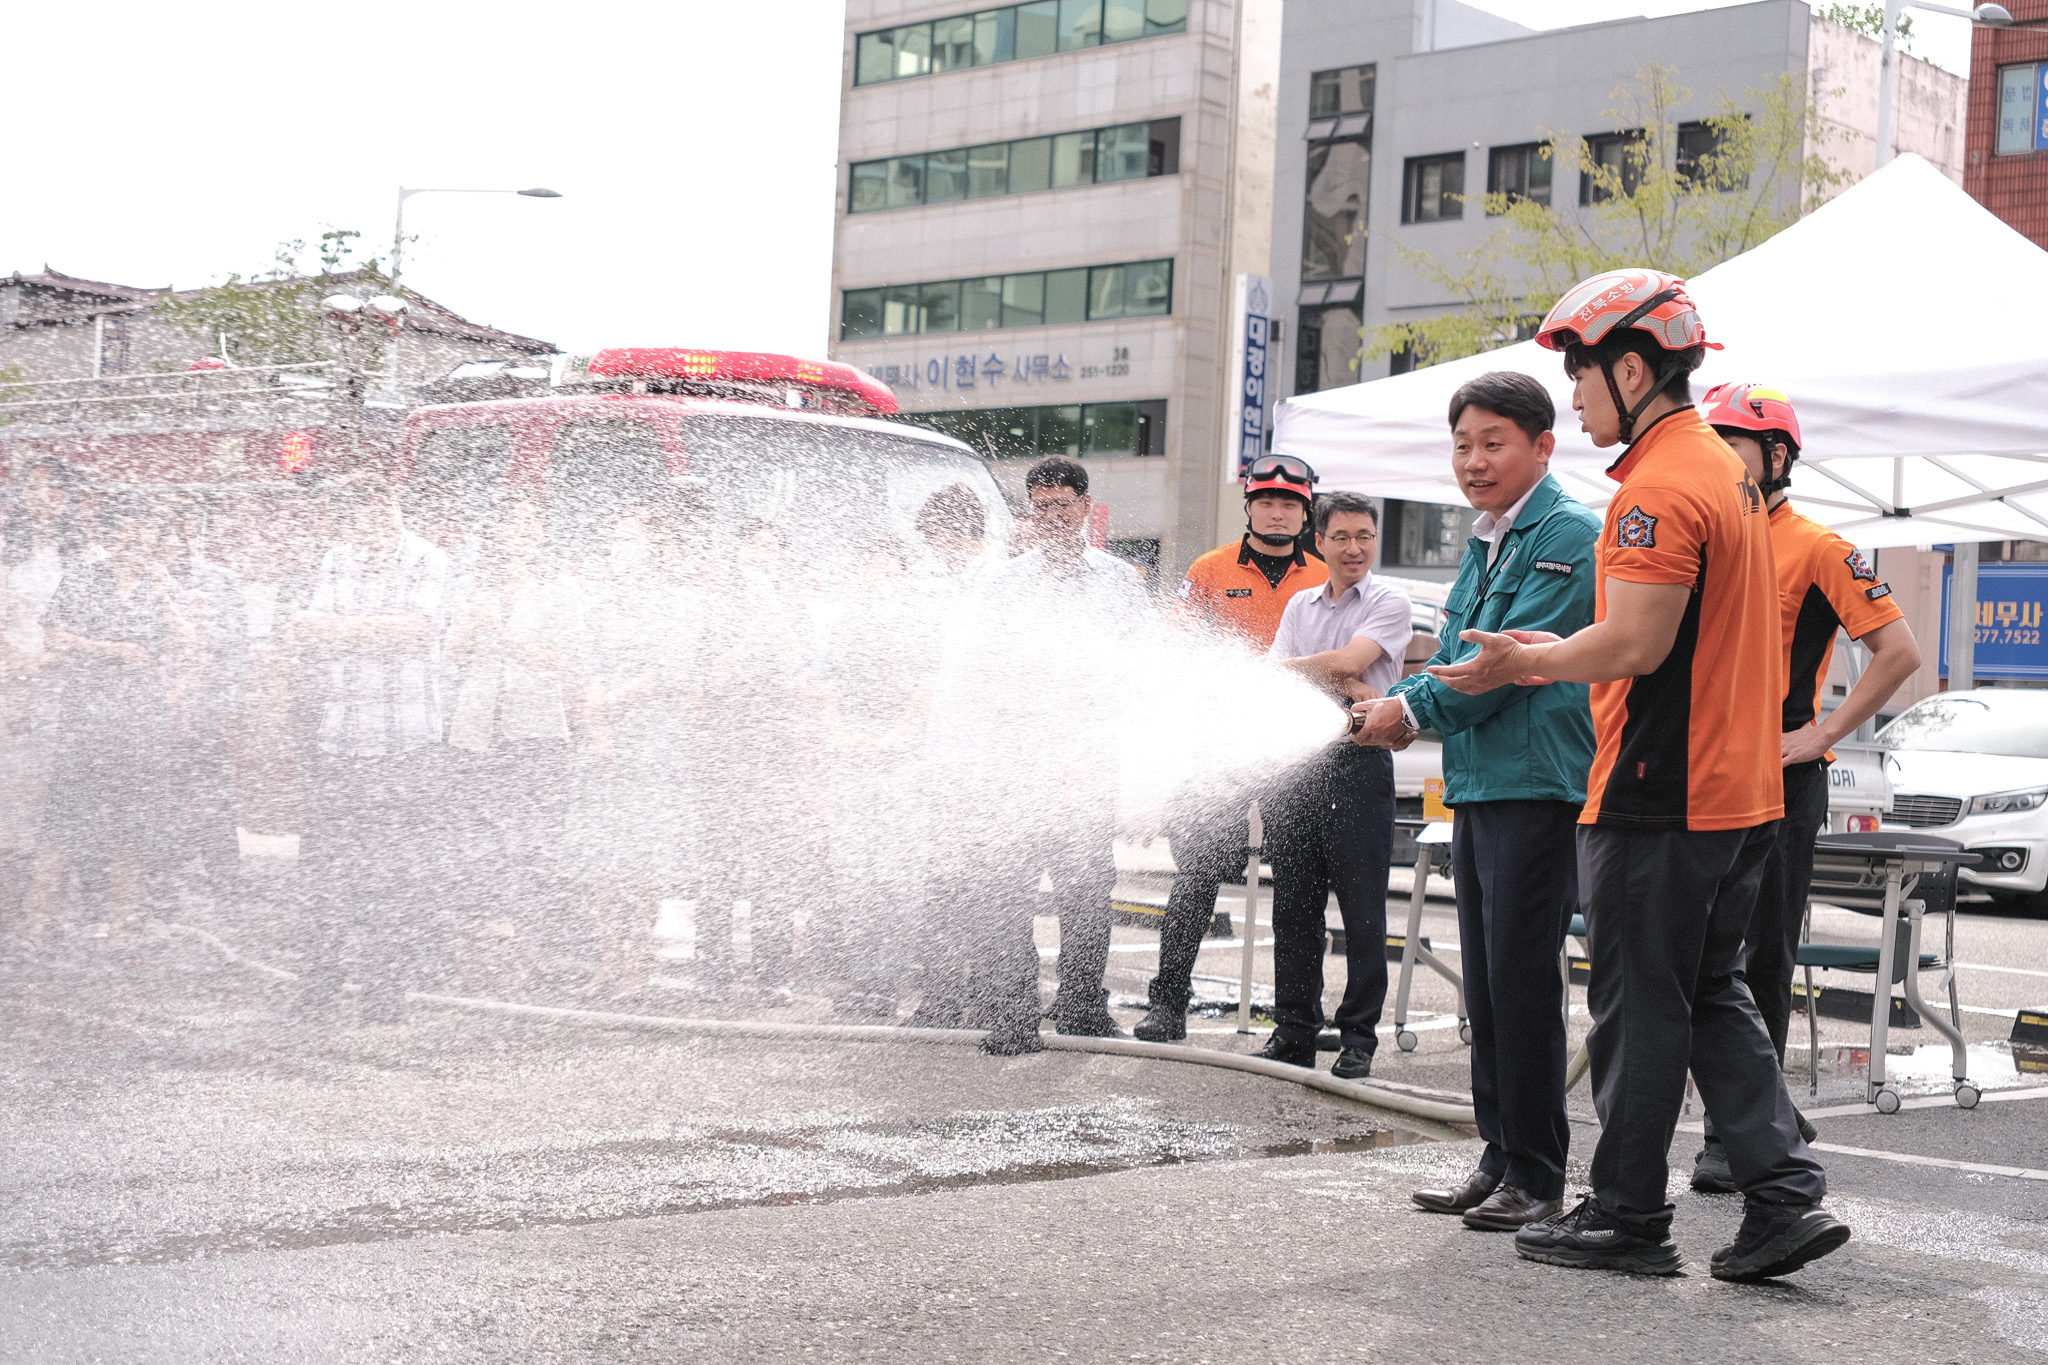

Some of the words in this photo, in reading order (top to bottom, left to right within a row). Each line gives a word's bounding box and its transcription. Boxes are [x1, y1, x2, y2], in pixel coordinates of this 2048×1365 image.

[1578, 282, 1635, 322] 전북소방
[927, 353, 1004, 389] 이현수
[1012, 352, 1071, 384] 사무소
